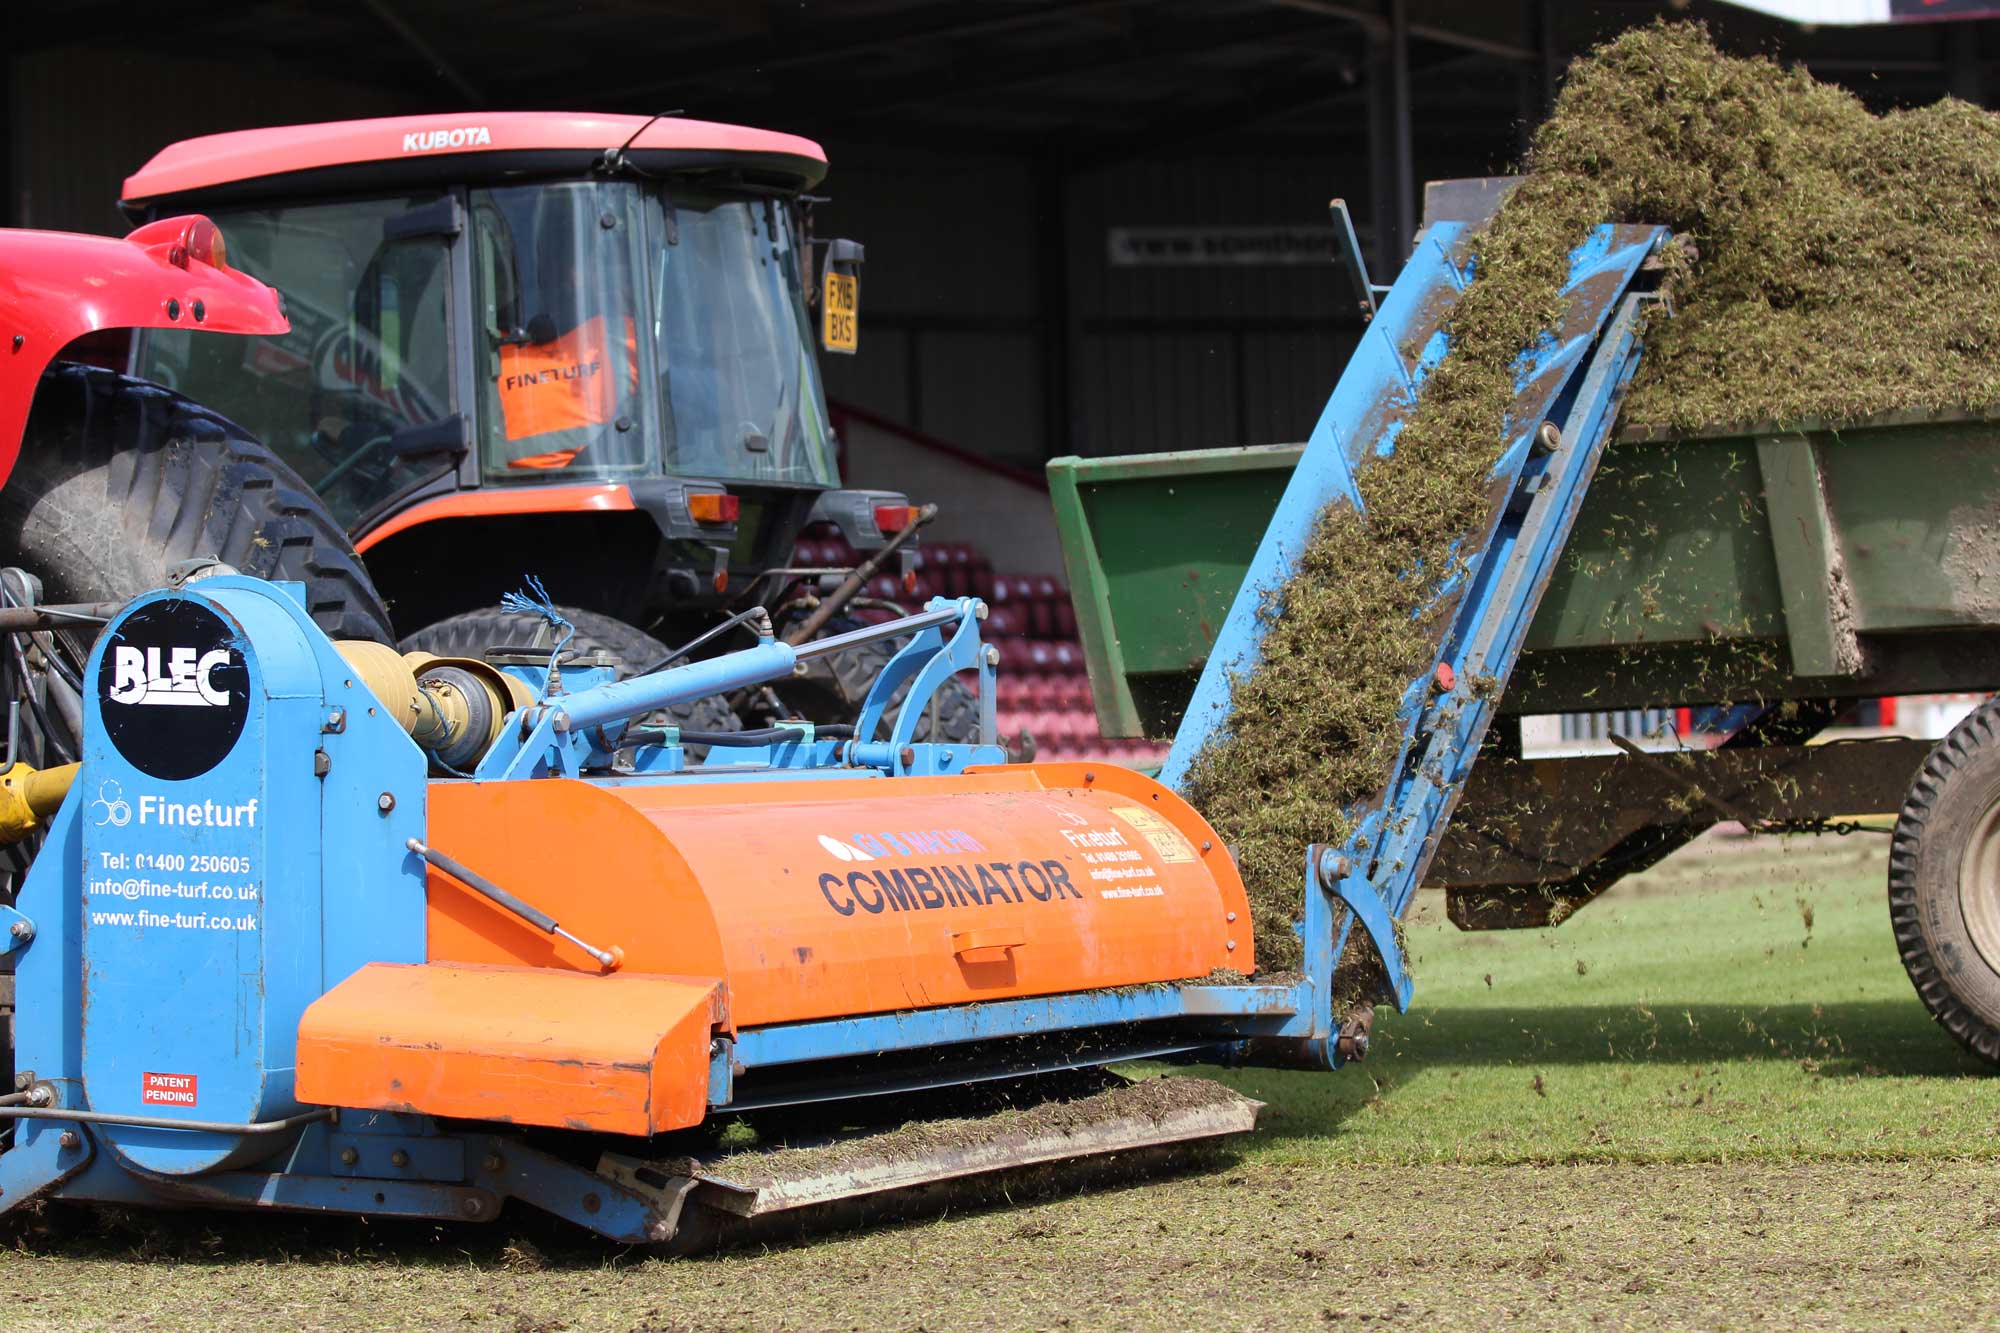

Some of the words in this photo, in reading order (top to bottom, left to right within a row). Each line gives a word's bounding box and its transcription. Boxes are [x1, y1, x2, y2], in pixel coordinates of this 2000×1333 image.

[403, 126, 491, 152] KUBOTA
[830, 280, 853, 311] FX15
[831, 313, 852, 342] BXS
[506, 362, 600, 391] FINETURF
[110, 646, 230, 706] BLEC
[139, 795, 259, 827] Fineturf
[101, 852, 130, 870] Tel:
[135, 853, 185, 871] 01400
[189, 855, 250, 873] 250605
[89, 878, 258, 900] info@fine-turf.co.uk
[818, 859, 1084, 917] COMBINATOR
[92, 909, 257, 931] www.fine-turf.co.uk
[150, 1076, 191, 1089] PATENT
[146, 1090, 194, 1103] PENDING
